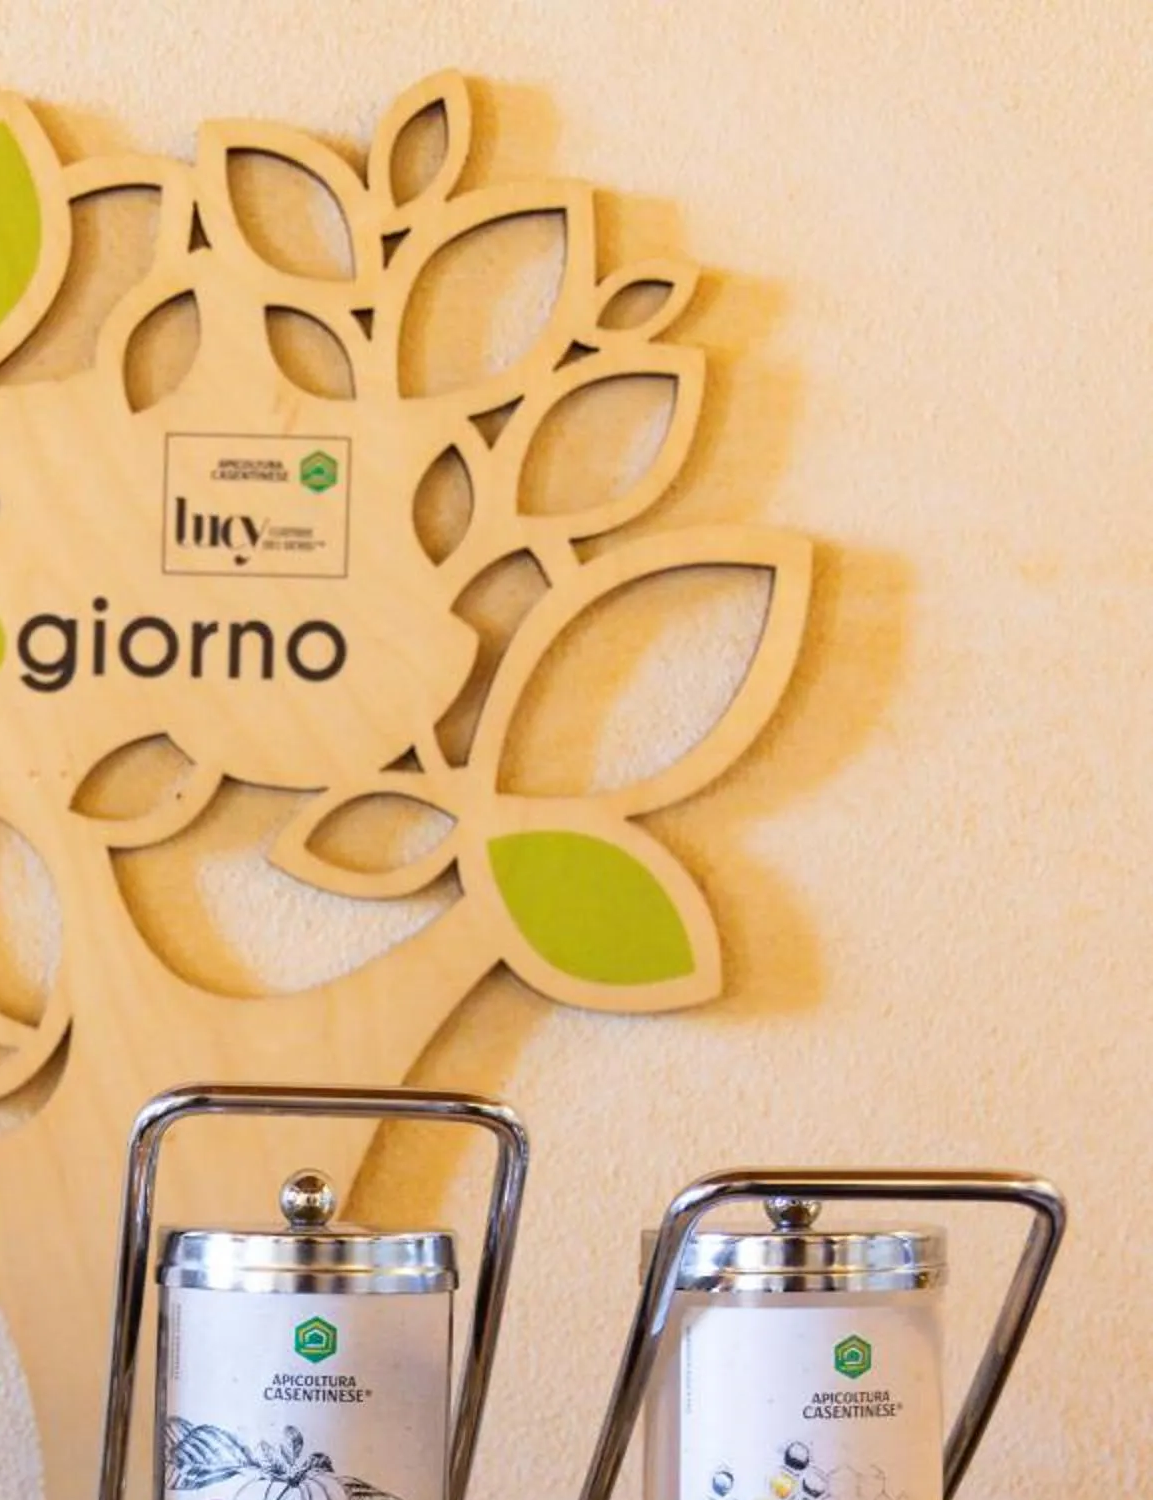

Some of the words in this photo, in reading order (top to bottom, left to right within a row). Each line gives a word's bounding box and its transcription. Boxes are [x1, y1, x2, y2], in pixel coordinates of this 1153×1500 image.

[175, 496, 270, 567] lucy
[272, 1374, 357, 1387] APICOLTURA
[811, 1391, 890, 1404] APICOLTURA
